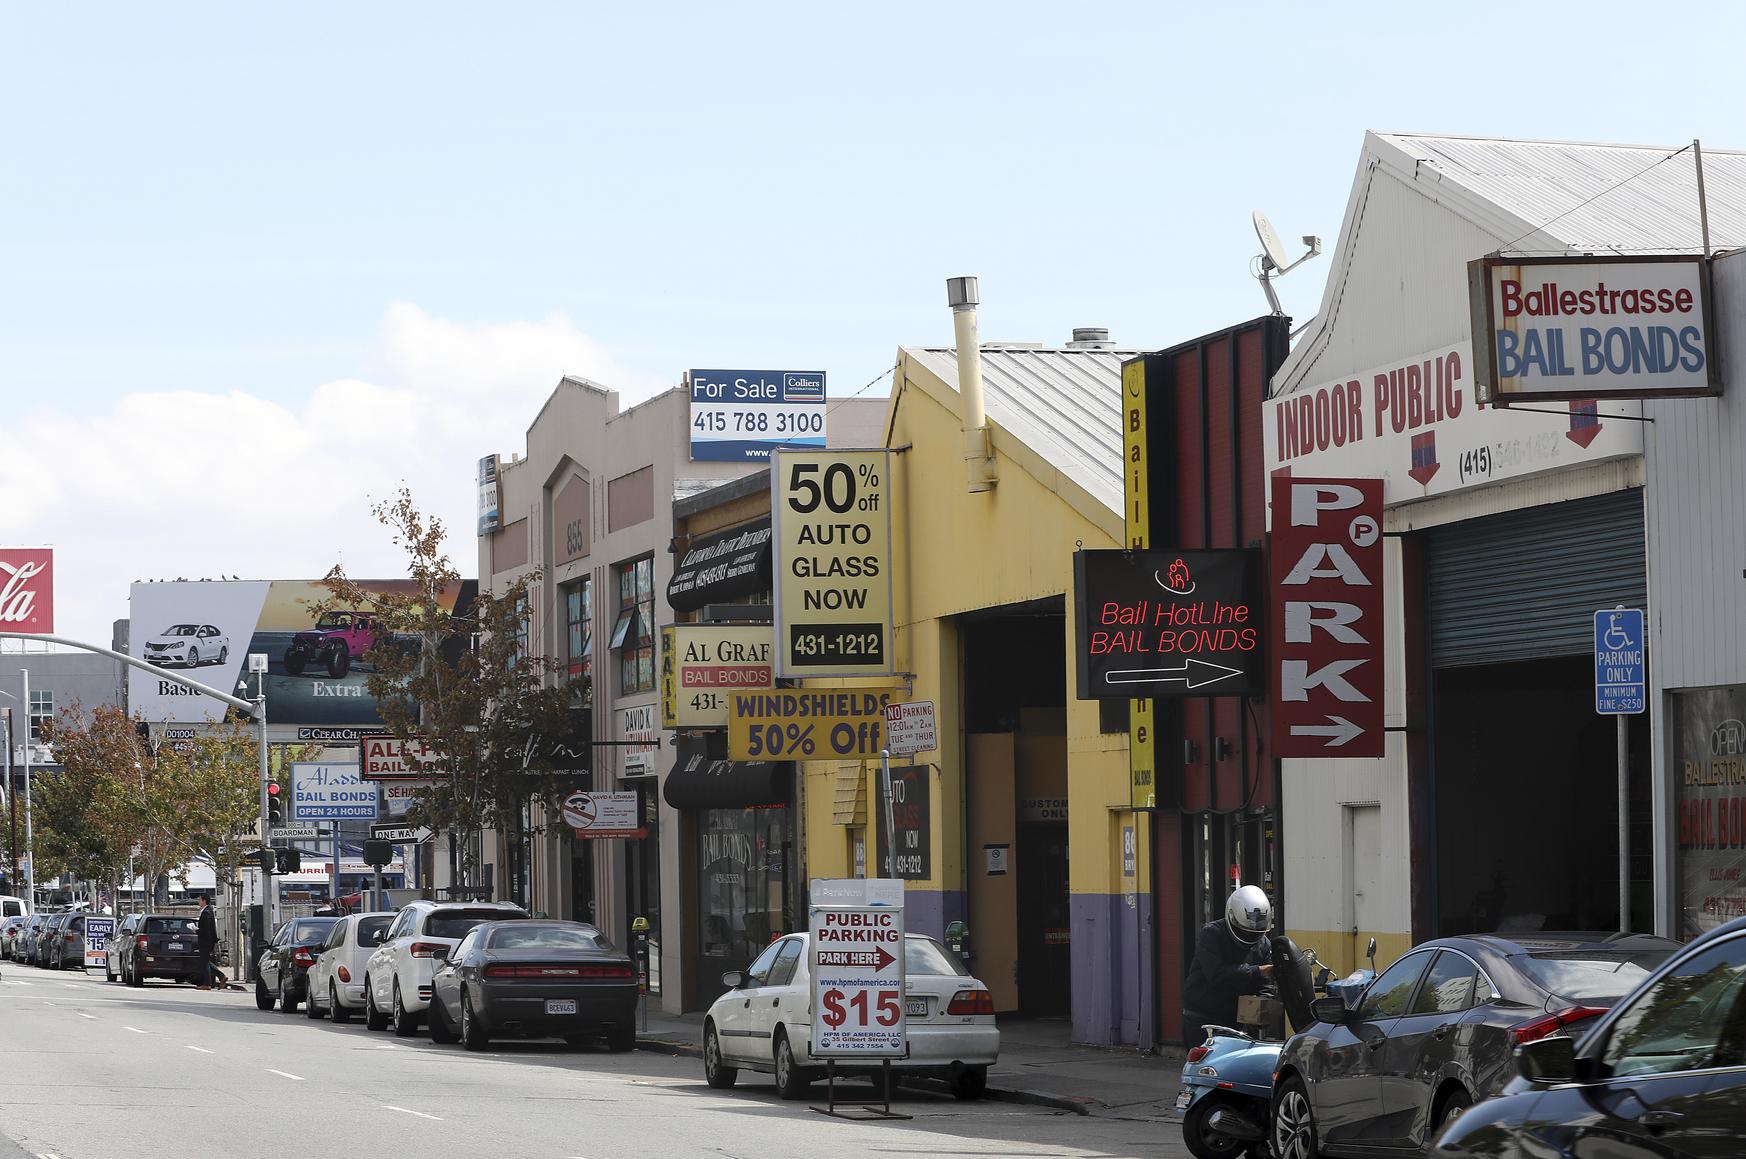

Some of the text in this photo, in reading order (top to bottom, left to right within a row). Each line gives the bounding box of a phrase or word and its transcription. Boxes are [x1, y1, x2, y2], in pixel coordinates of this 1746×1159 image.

[1501, 280, 1693, 317] Ballestrasse
[1497, 326, 1705, 378] BAIL BONDS
[694, 378, 777, 398] For Sale
[788, 378, 820, 387] Colliers
[1276, 351, 1462, 462] INDOOR PUBLIC
[694, 411, 822, 433] 415 788 3100
[1459, 445, 1492, 484] (415)
[858, 494, 879, 511] off
[567, 519, 583, 556] 855
[797, 523, 871, 545] AUTO
[792, 556, 879, 578] GLASS
[804, 589, 867, 610] NOW
[1281, 484, 1374, 703] PARK
[1101, 600, 1148, 625] Bail
[717, 640, 769, 662] GRAF
[795, 633, 879, 655] 431-1212
[1090, 628, 1257, 654] BAIL BONDS
[1598, 651, 1641, 666] PARKING
[685, 670, 768, 683] BAIL BONDS
[1606, 667, 1633, 682] ONLY
[312, 681, 362, 697] Extra
[1604, 687, 1637, 697] MINIMUM
[736, 693, 891, 718] WINDSHIELDS
[887, 706, 933, 720] NO PARKING
[1600, 698, 1642, 709] FINE $250
[625, 709, 644, 732] DAVID
[748, 722, 880, 756] 50% Off
[891, 735, 904, 743] TUE
[915, 732, 934, 741] THUR
[1711, 728, 1745, 756] OPEN
[370, 762, 405, 773] BAIL
[1684, 759, 1746, 786] BALLESTRA
[296, 792, 376, 802] BAIL BONDS
[299, 808, 324, 816] OPEN
[340, 807, 373, 815] HOURS
[273, 829, 314, 837] BOARDMAN
[377, 829, 417, 839] ONE WAY
[905, 831, 918, 848] NOW
[703, 832, 752, 871] BAIL BONDS
[896, 856, 922, 874] 431-1212
[89, 924, 112, 932] EARLY
[825, 914, 892, 927] PUBLIC
[818, 929, 899, 942] PARKING
[819, 952, 880, 964] PARK HERE
[822, 988, 901, 1031] $15
